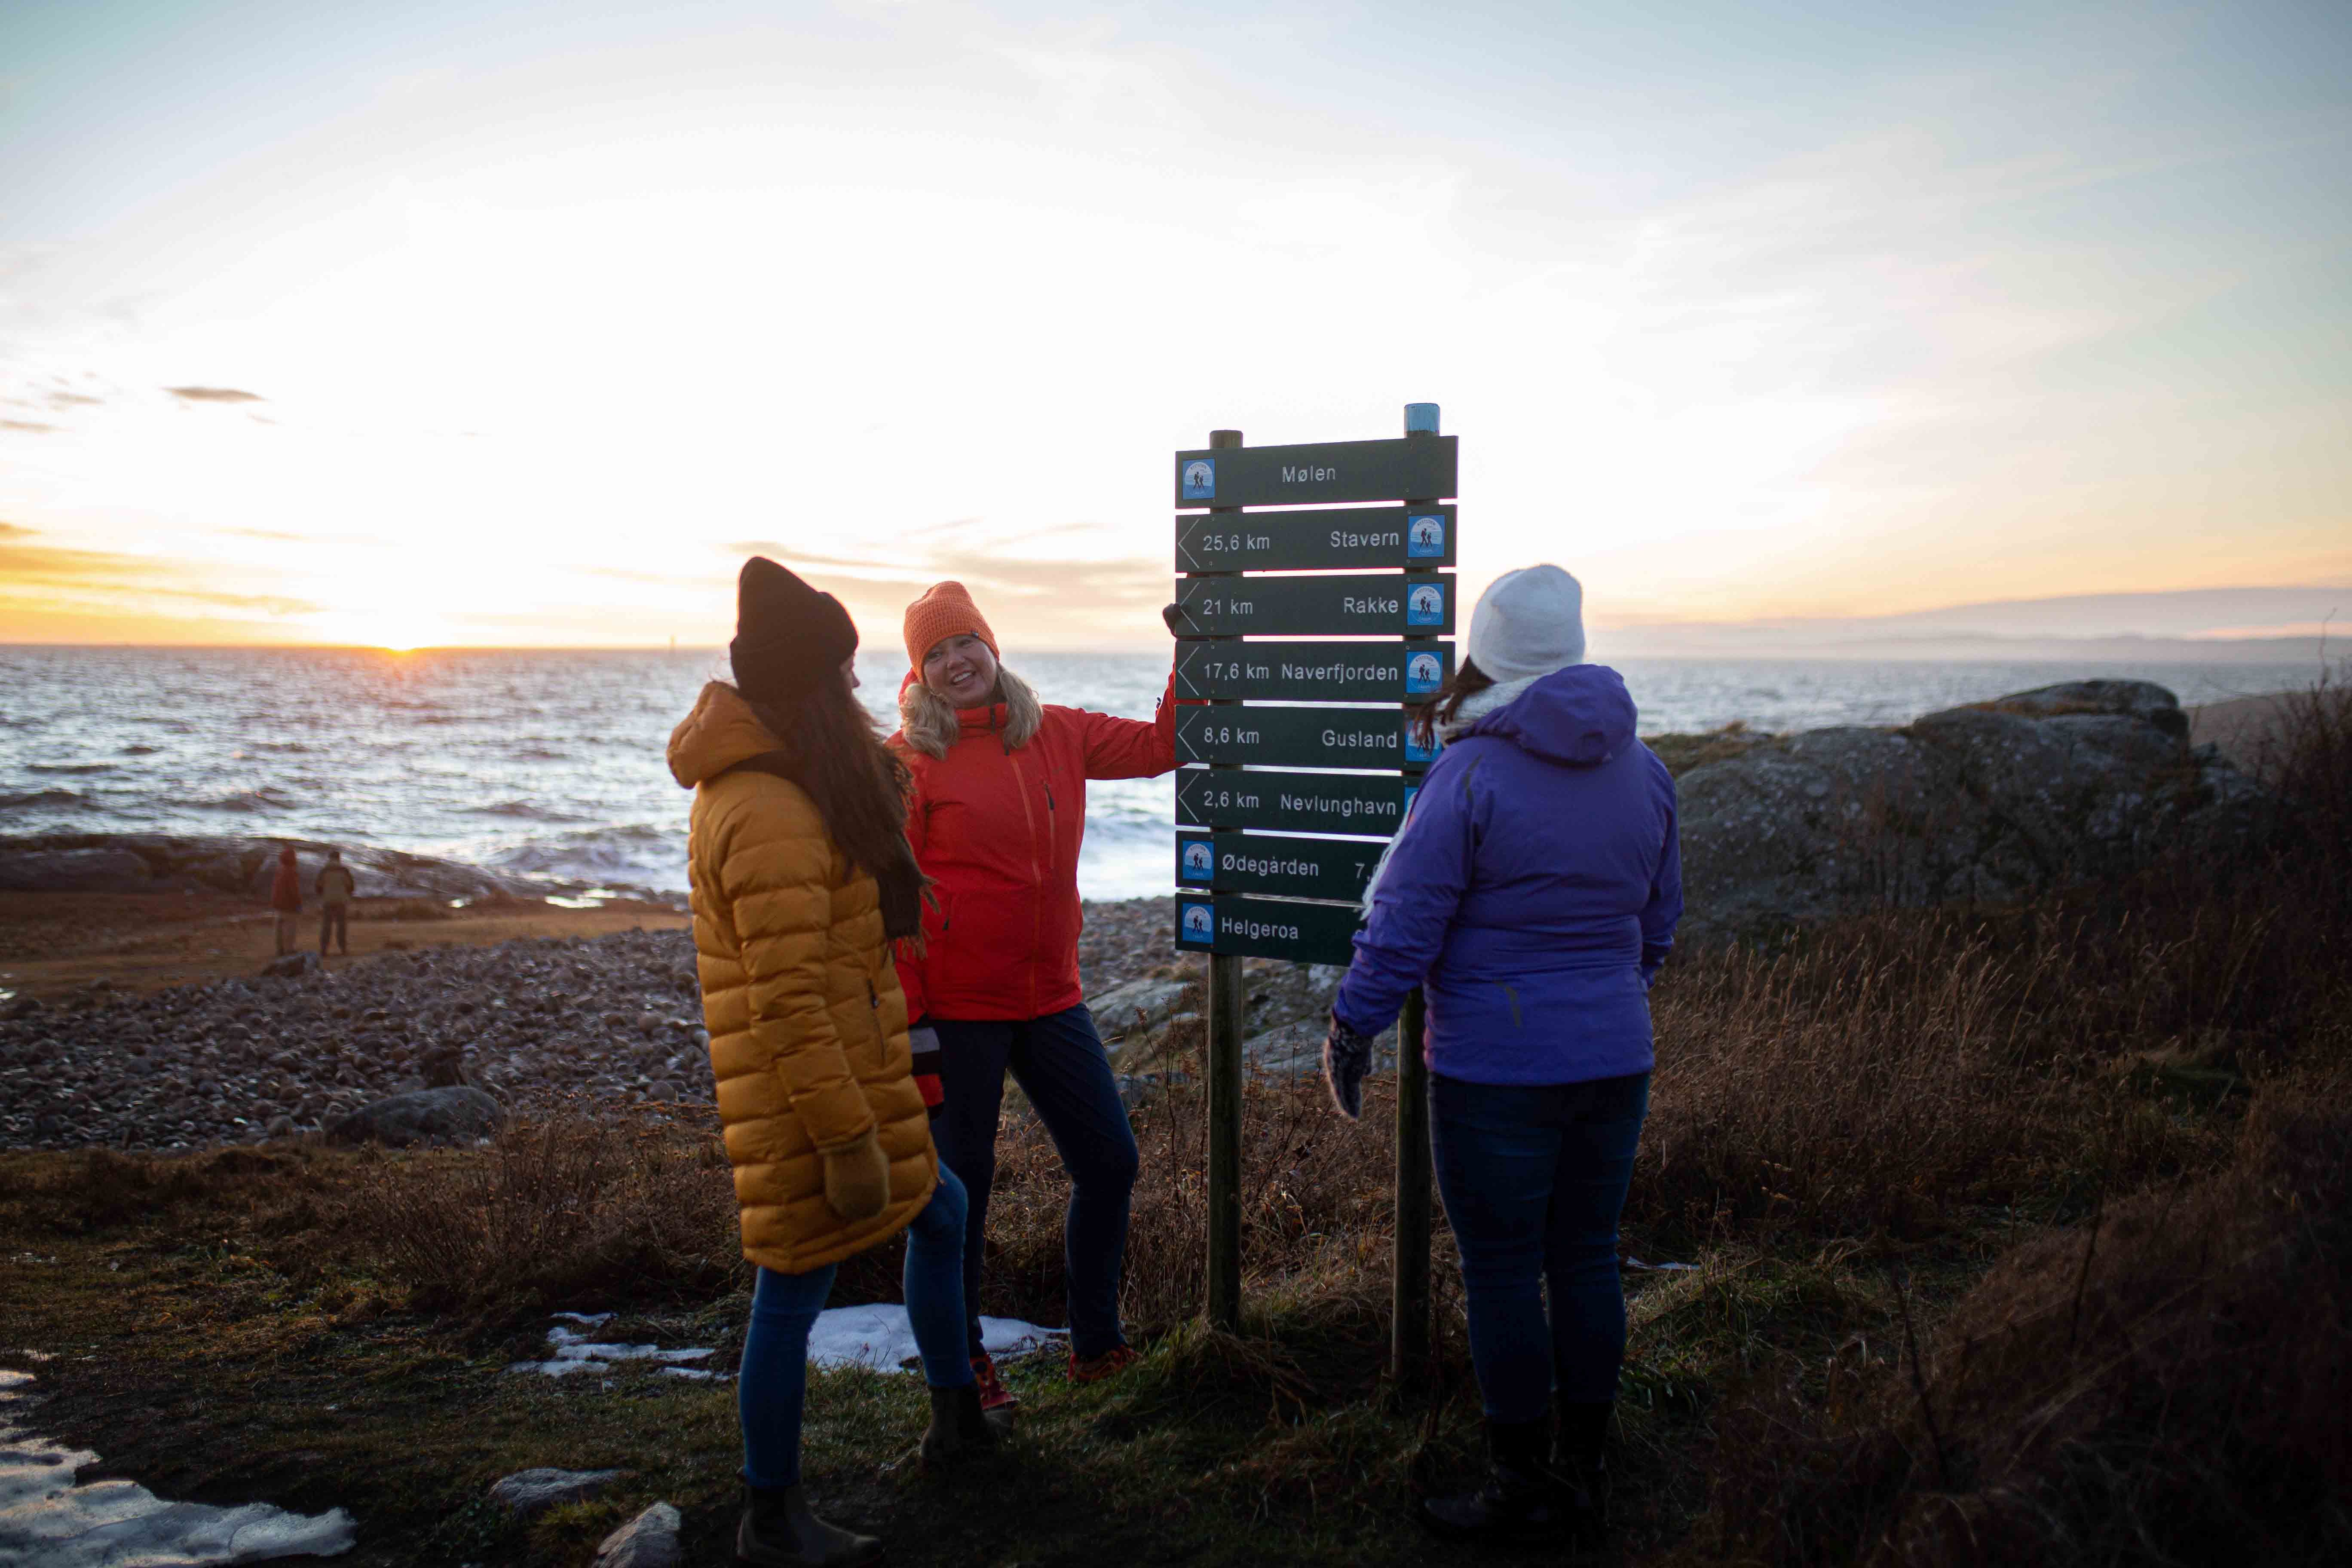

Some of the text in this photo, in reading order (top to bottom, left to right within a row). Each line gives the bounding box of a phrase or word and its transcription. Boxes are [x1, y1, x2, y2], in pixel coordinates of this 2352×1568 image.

[1282, 466, 1335, 482] Mølen
[1203, 531, 1399, 552] 25,6 km Stavern
[1203, 597, 1399, 615] 21 km Rakke
[1204, 662, 1397, 684] 17,6 km Naverfjorden
[1204, 727, 1397, 748] 8,6 km Gusland
[1204, 790, 1396, 817] 2,6 km Nevlunghavn
[1222, 854, 1318, 876] Ødegården
[1222, 917, 1298, 939] Helgeroa
